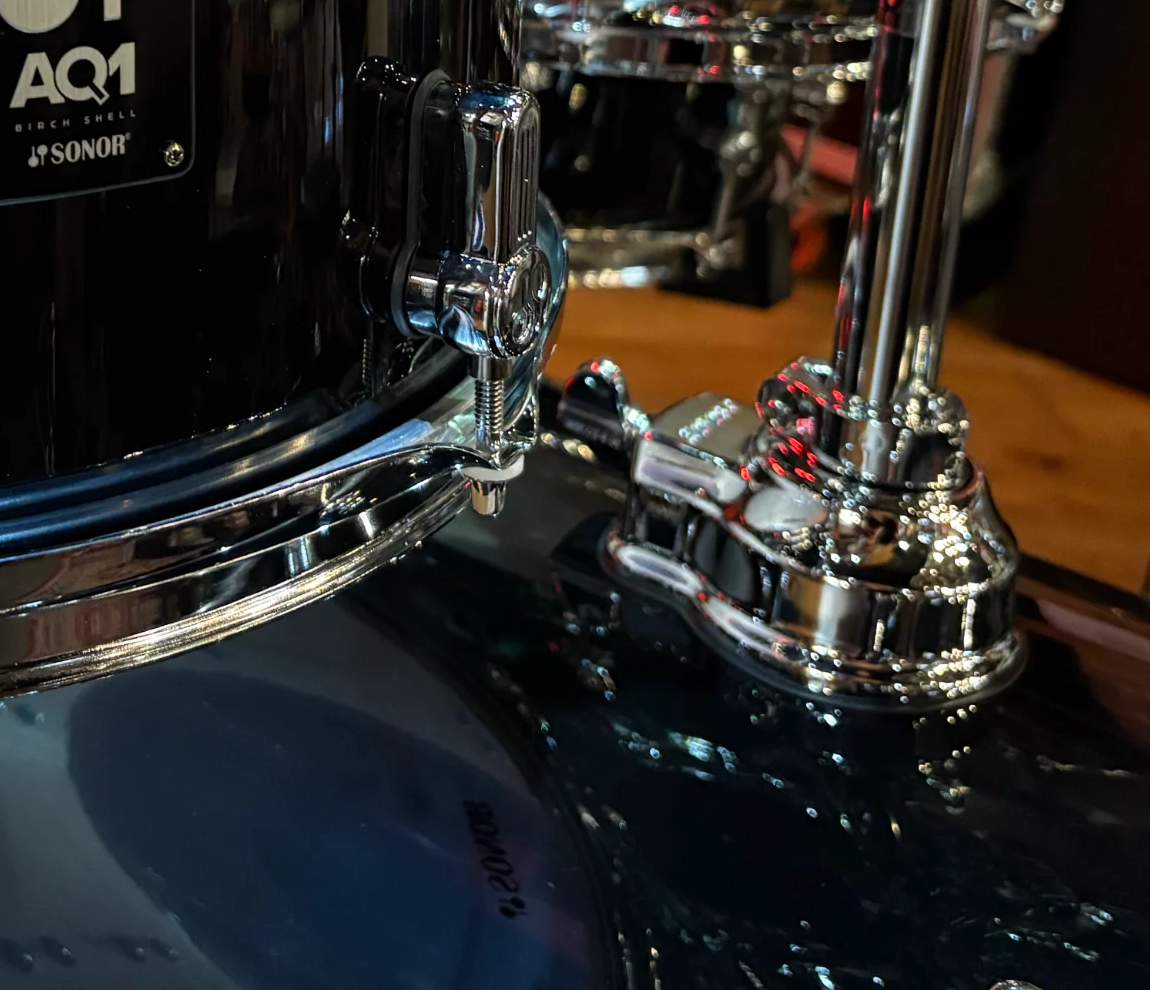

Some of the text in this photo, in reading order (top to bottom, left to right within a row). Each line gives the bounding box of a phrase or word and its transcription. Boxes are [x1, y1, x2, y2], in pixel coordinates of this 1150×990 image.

[9, 42, 135, 108] AQ1
[15, 109, 136, 132] BIRCH SHELL
